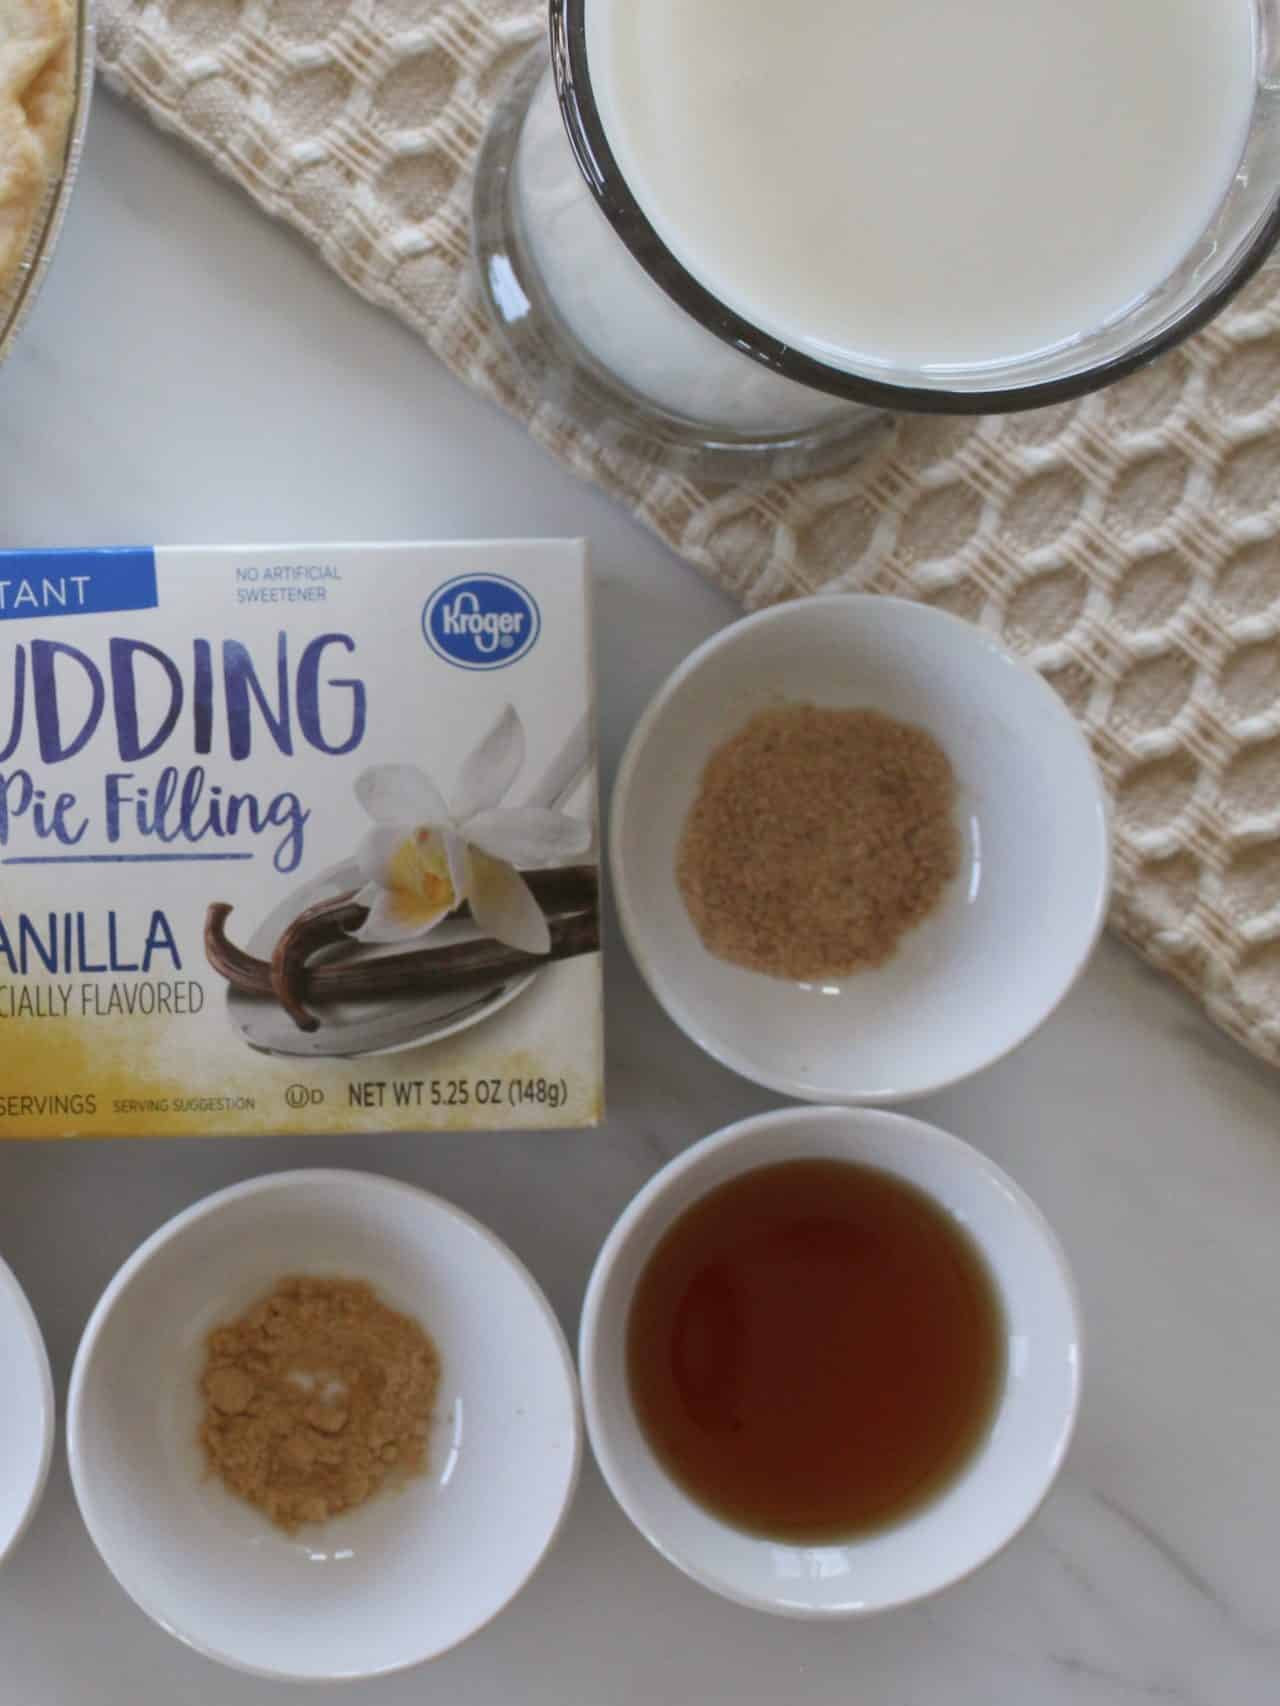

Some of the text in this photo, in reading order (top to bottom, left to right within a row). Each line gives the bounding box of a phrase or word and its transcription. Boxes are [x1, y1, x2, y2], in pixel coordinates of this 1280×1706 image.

[235, 565, 342, 583] NO ARTIFICIAL
[236, 587, 328, 604] SWEETENER
[442, 592, 524, 653] Kroger
[104, 765, 312, 873] Filling
[81, 980, 205, 1016] FLAVORED
[112, 1097, 256, 1114] SERVING SUGGESTION
[348, 1077, 569, 1109] NET WT 5.25 OZ (148g)
